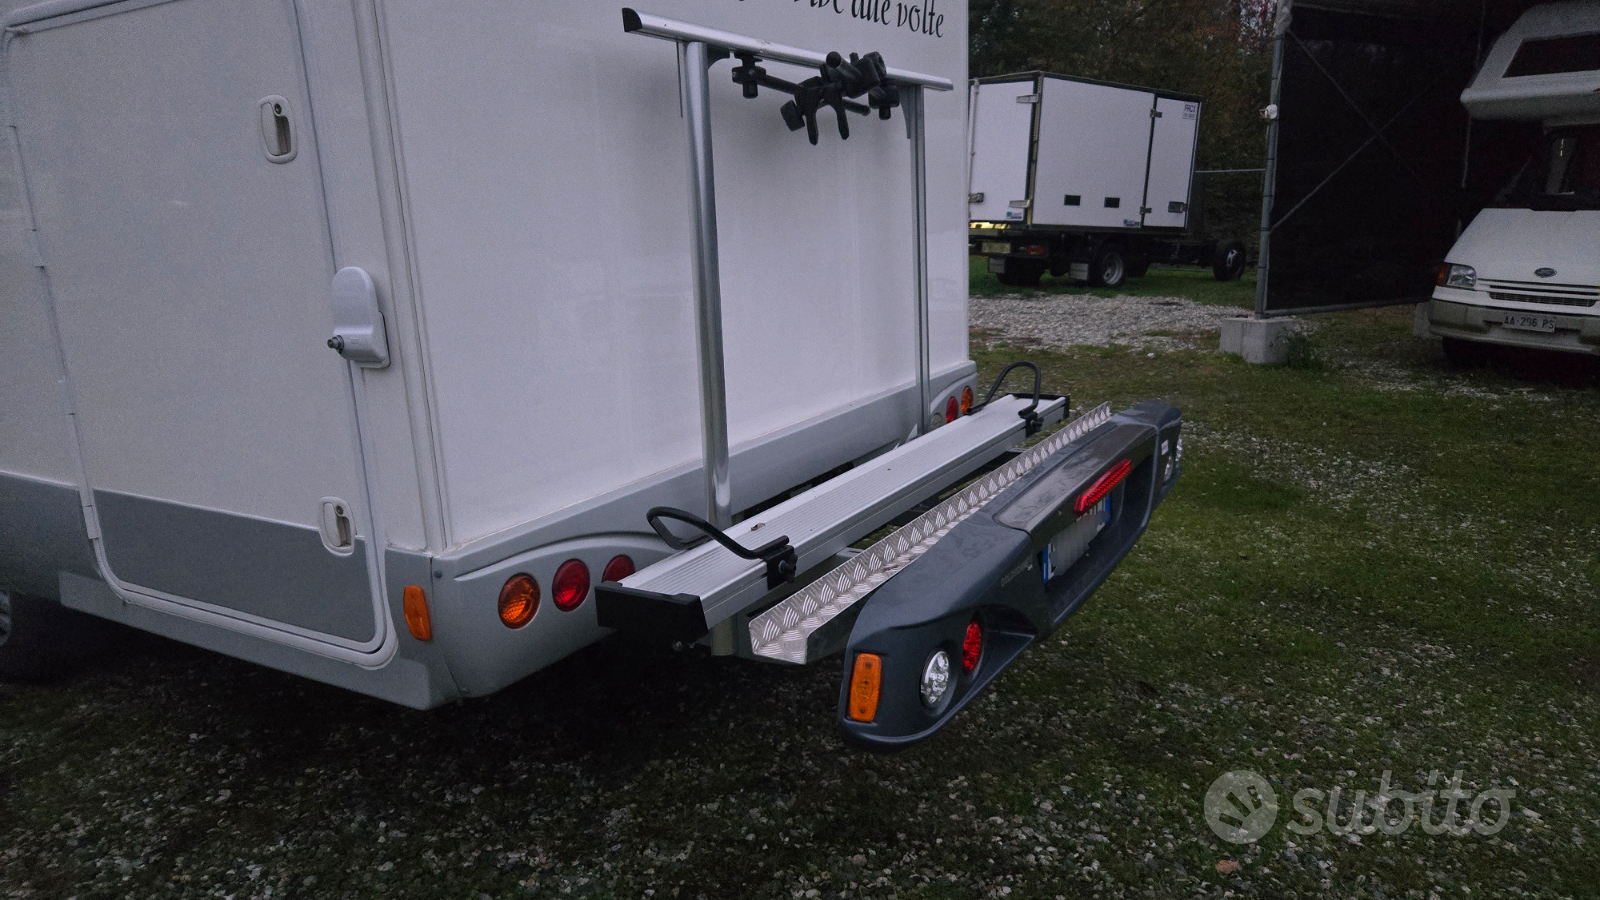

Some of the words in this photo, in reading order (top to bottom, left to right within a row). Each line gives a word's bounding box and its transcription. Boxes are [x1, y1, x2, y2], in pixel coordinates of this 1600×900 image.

[896, 0, 944, 38] volte
[1503, 315, 1515, 325] AA
[1541, 318, 1555, 330] PS
